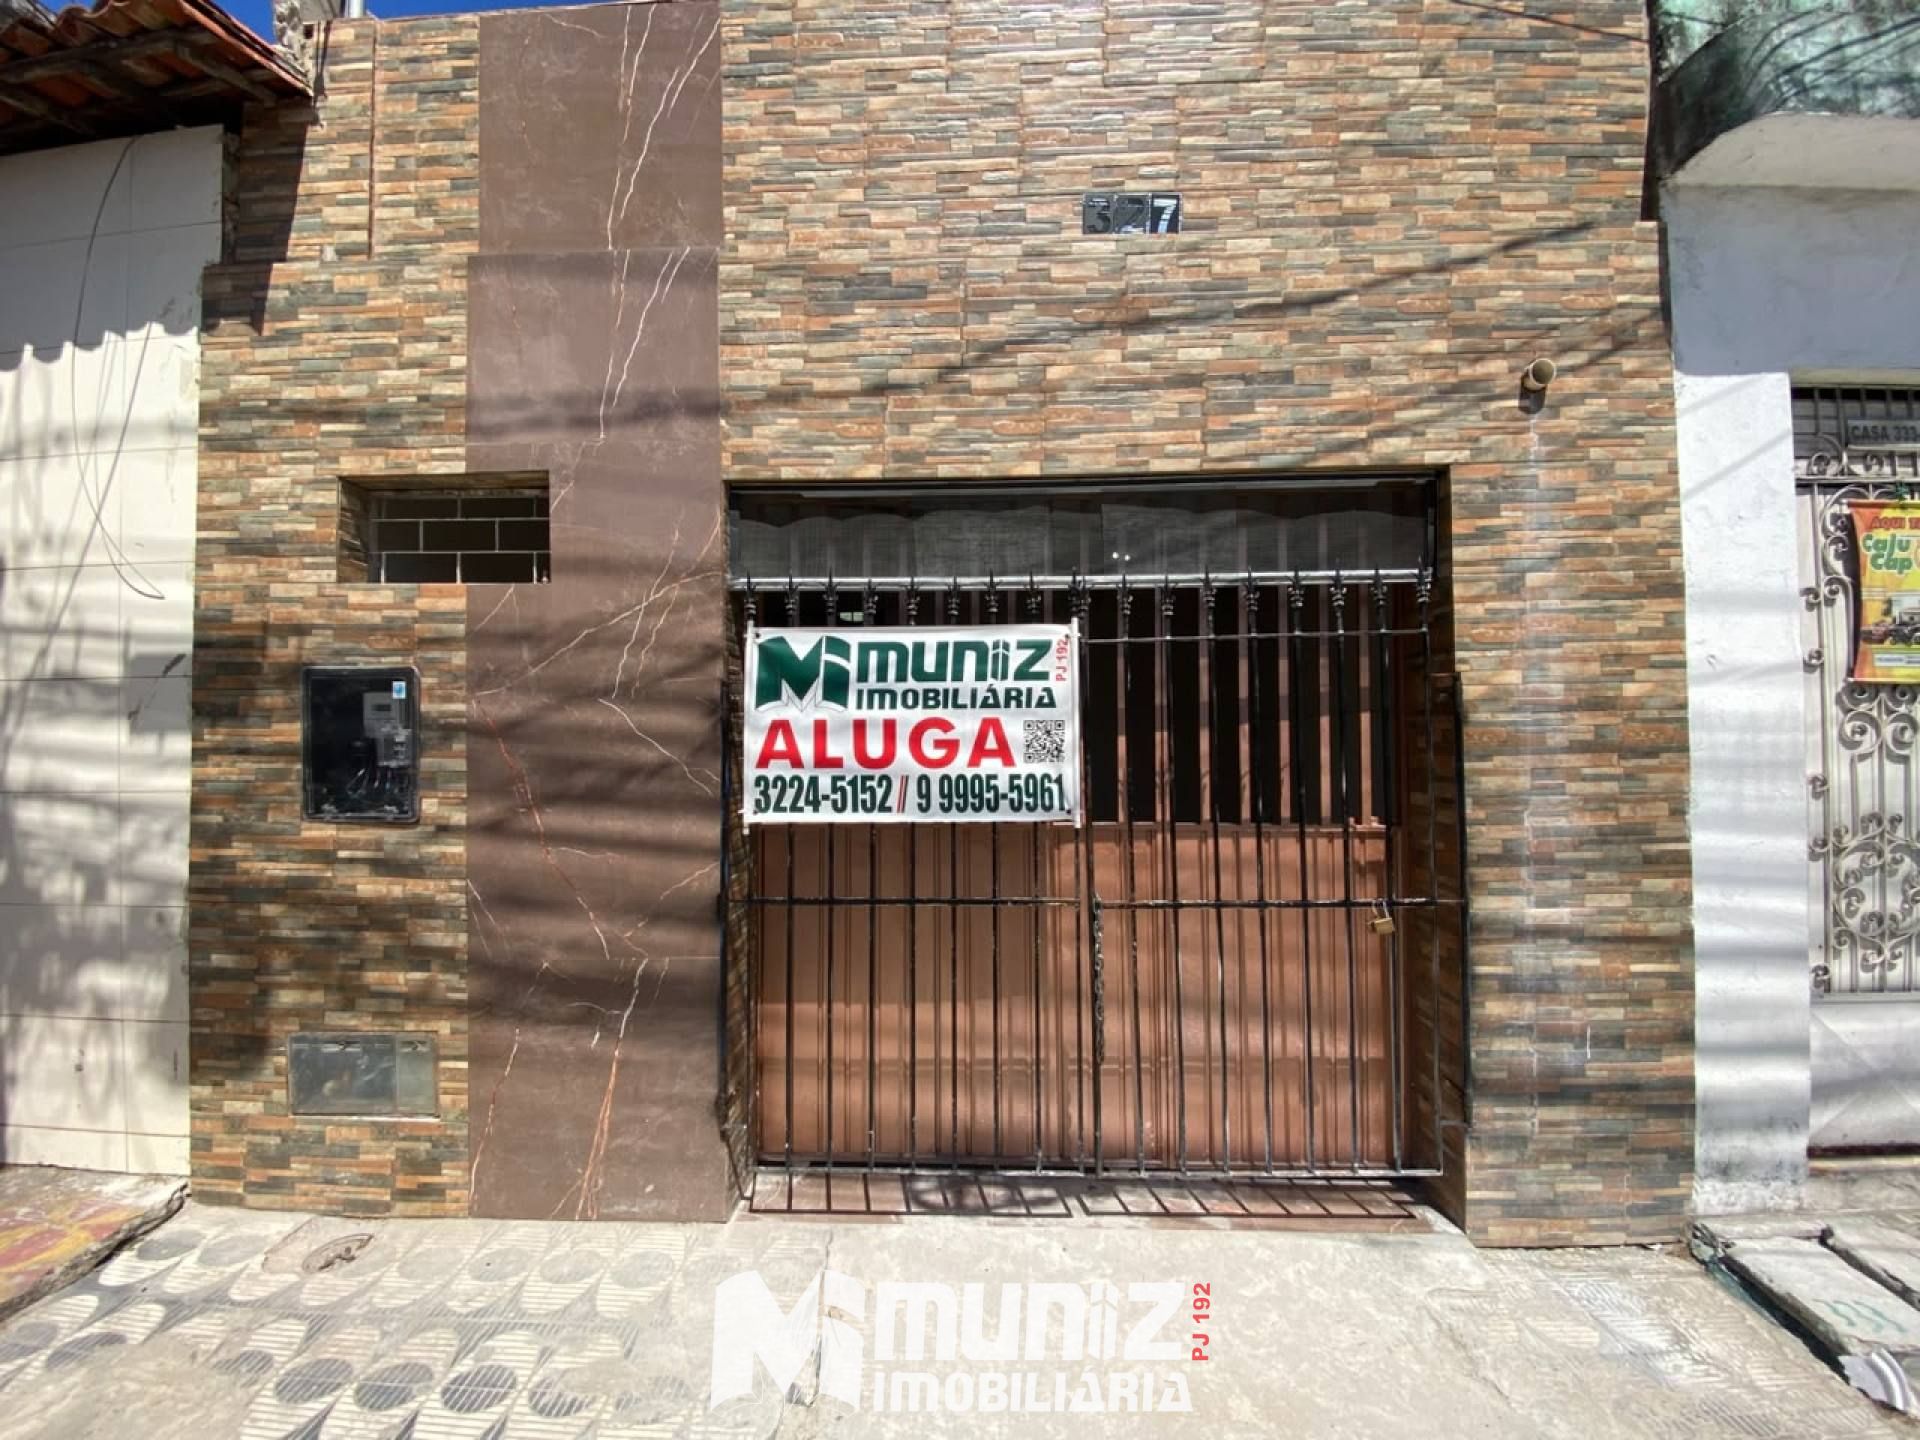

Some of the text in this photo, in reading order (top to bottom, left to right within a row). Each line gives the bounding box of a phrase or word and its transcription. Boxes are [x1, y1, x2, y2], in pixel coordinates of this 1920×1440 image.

[1851, 425, 1889, 441] CASA
[1871, 516, 1906, 531] AQUI
[1056, 639, 1069, 682] PJ 192
[755, 717, 1017, 770] ALUGA
[754, 774, 893, 814] 3224-5152
[916, 774, 931, 814] 9
[938, 773, 1066, 814] 9995-5961
